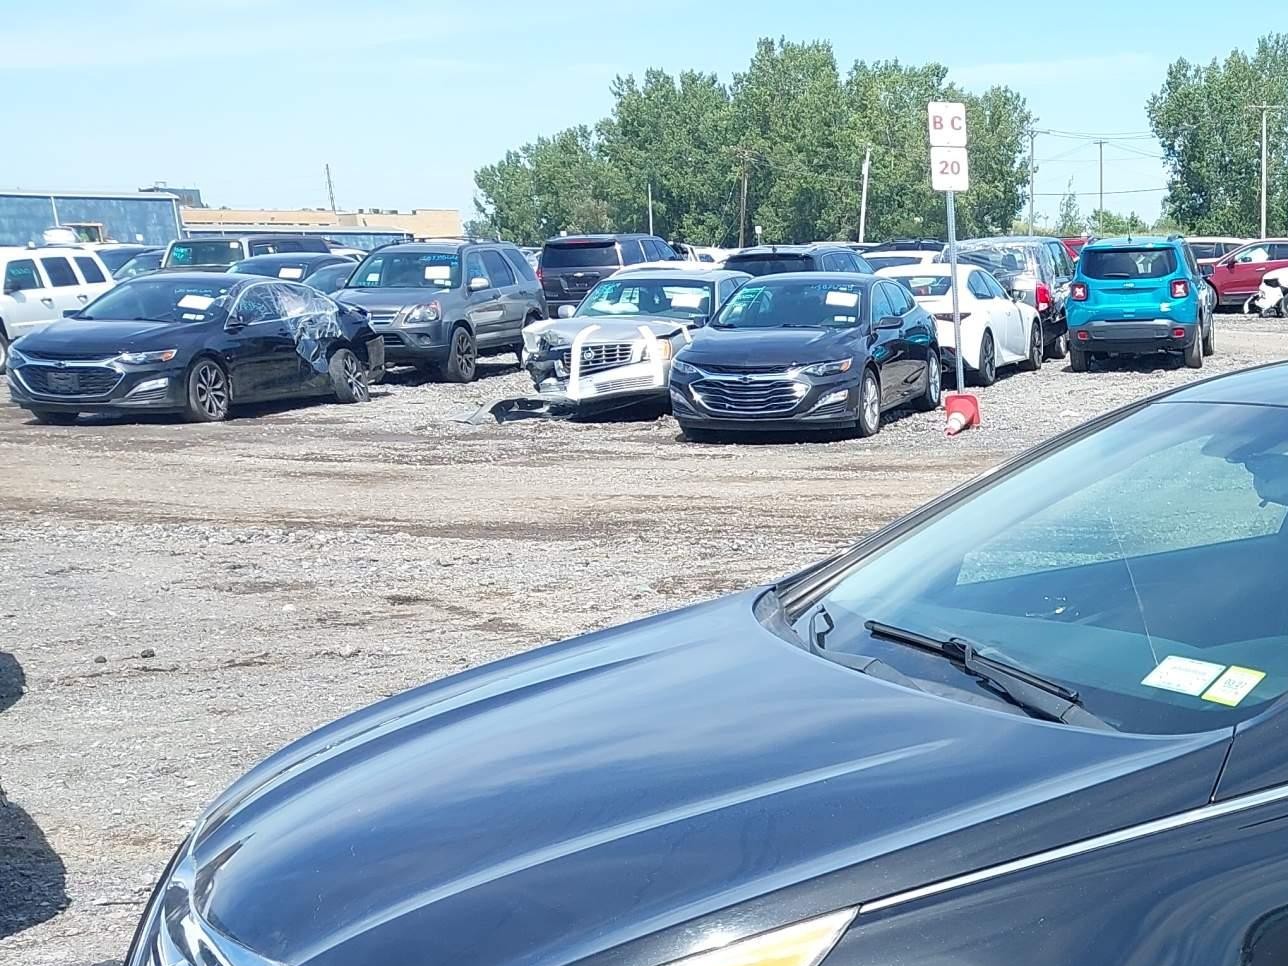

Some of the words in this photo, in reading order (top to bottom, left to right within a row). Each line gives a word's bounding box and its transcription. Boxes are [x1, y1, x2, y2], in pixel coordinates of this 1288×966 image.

[933, 115, 944, 130] B
[950, 115, 962, 131] C
[939, 160, 961, 175] 20
